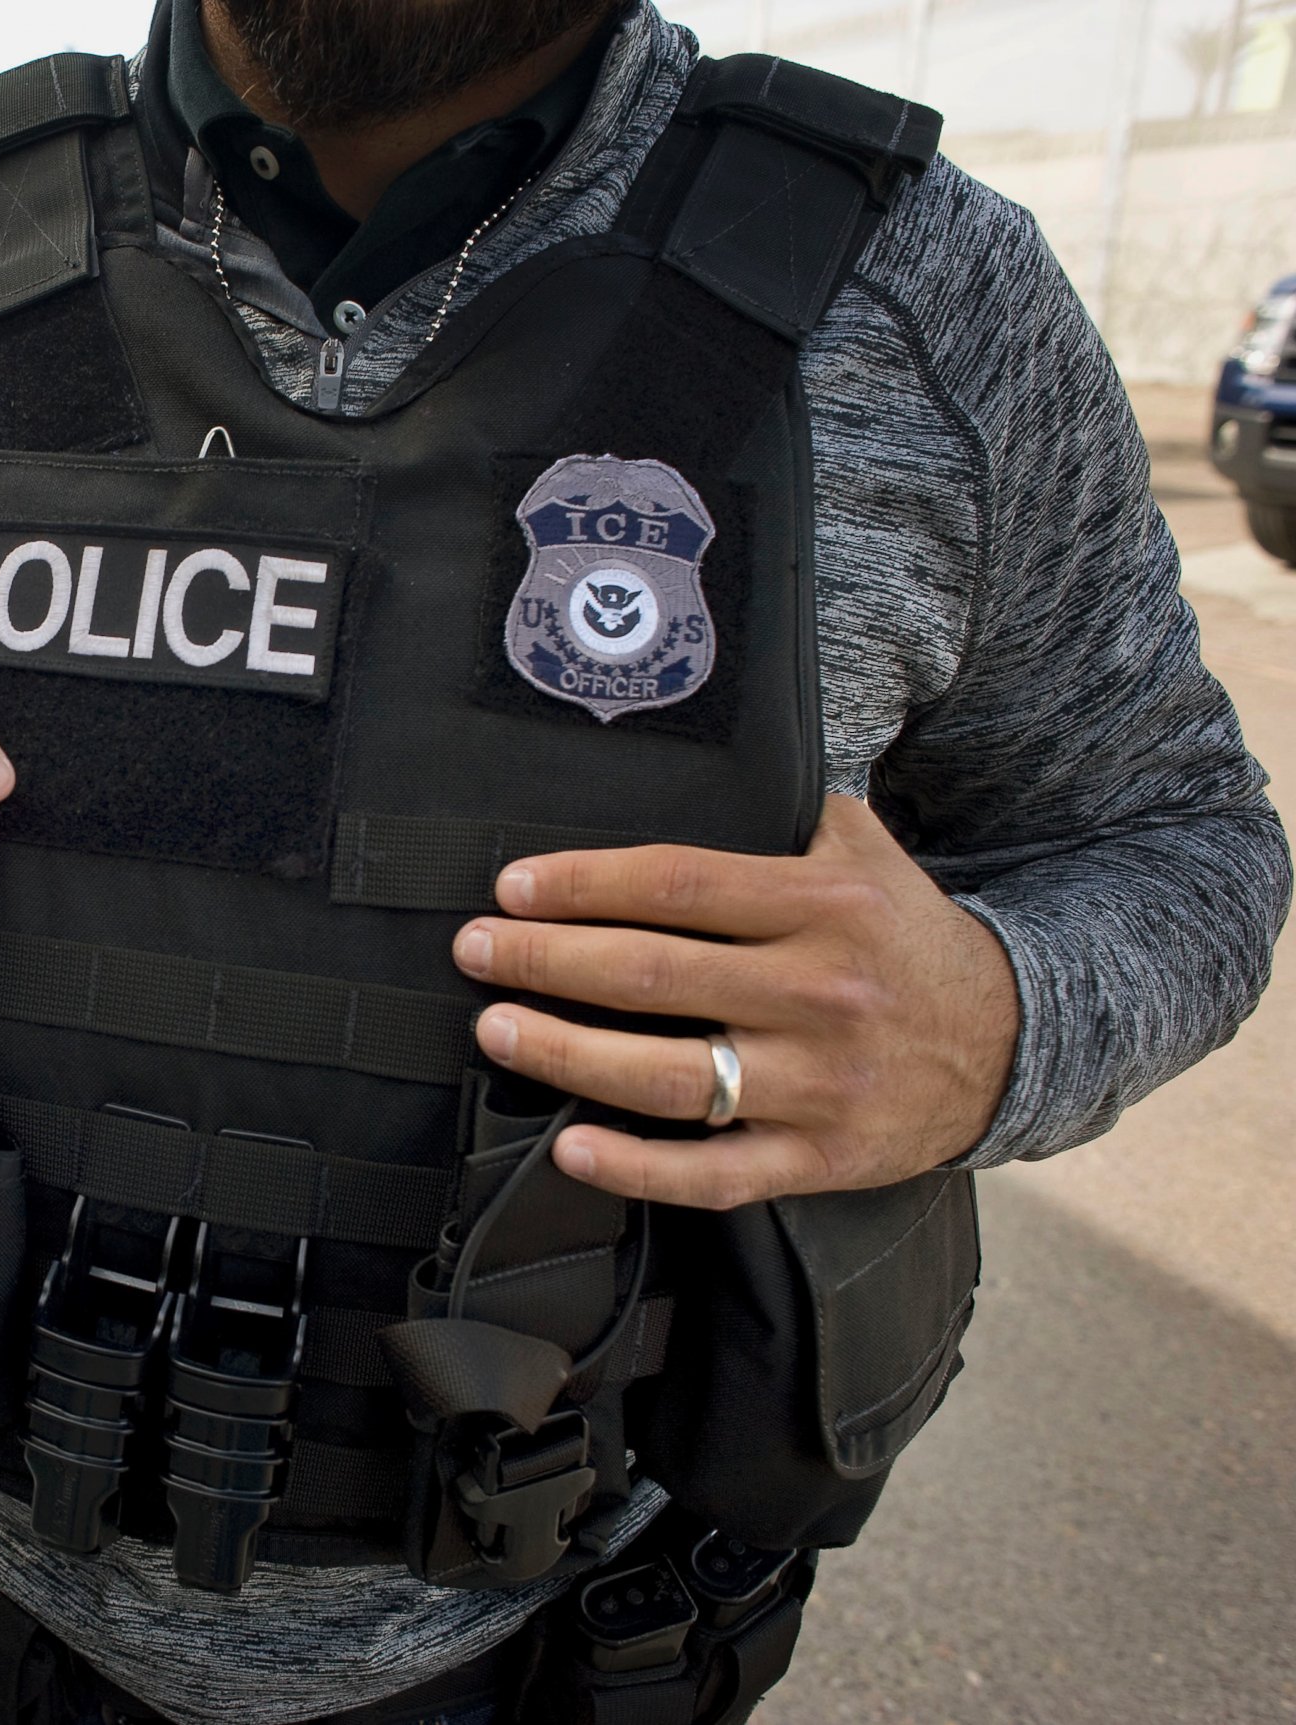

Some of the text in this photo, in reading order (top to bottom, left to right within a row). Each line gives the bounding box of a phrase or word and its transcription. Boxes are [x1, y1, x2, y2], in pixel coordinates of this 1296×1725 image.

[566, 513, 669, 549] ICE
[521, 598, 705, 645] U S
[560, 669, 658, 697] OFFICER
